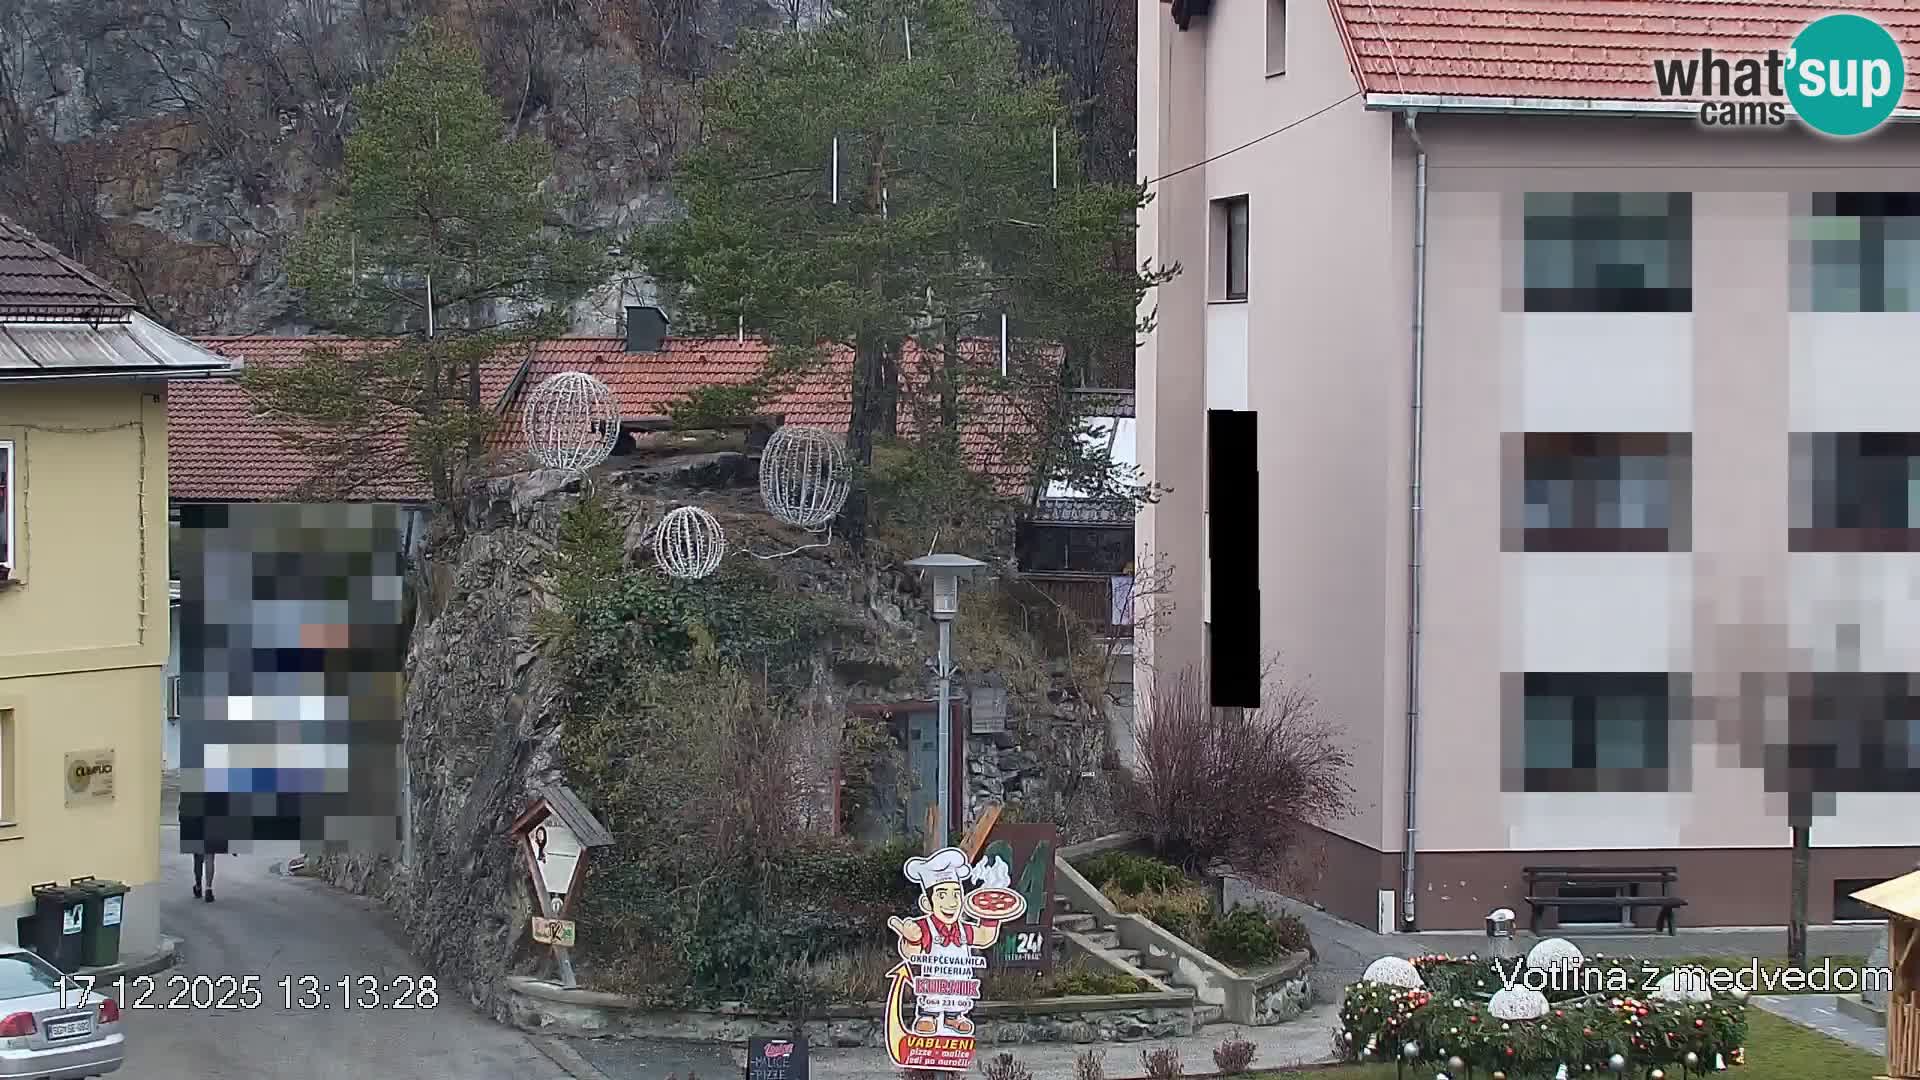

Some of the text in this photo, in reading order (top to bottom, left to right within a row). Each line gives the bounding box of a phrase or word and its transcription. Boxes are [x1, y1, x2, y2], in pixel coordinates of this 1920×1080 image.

[910, 955, 985, 966] OKREPČEVALNICA
[923, 965, 972, 976] IN PICERIJA
[907, 1036, 974, 1050] VABLJENI
[909, 1048, 932, 1057] pizze
